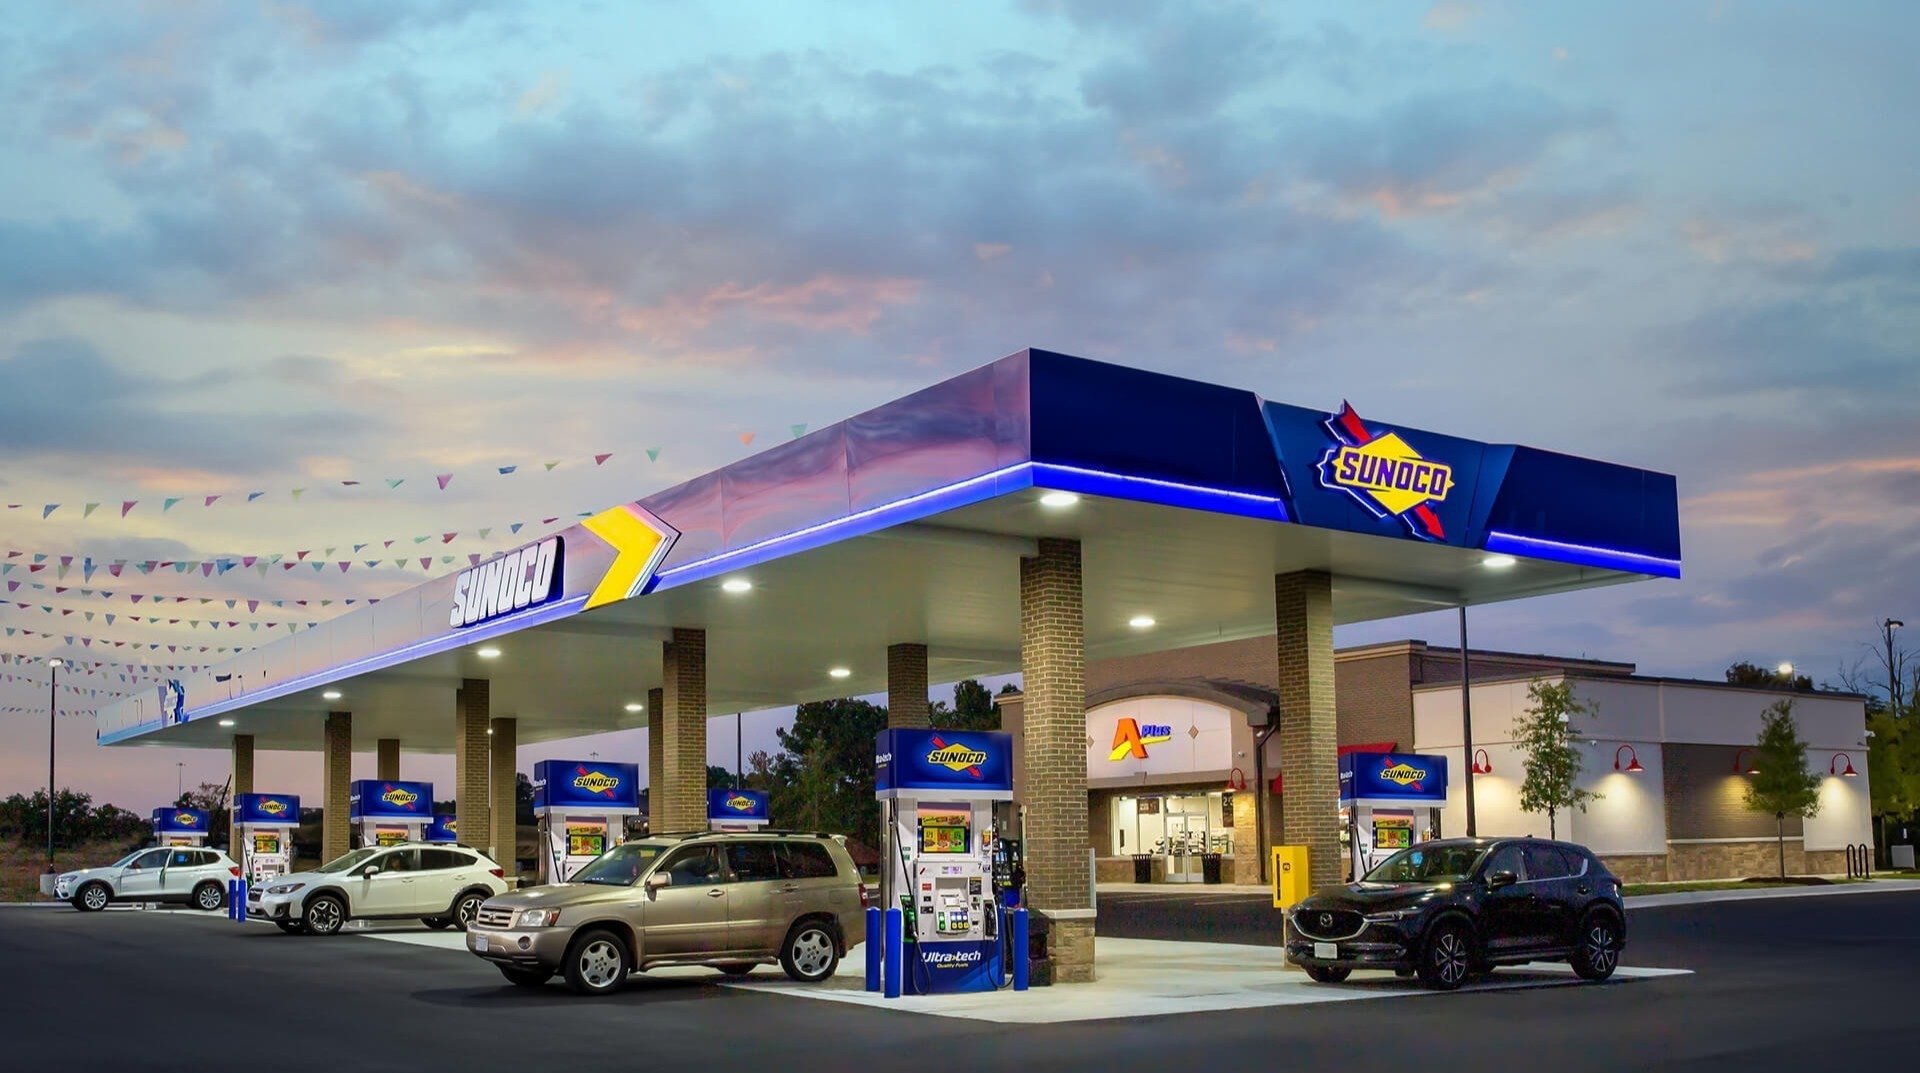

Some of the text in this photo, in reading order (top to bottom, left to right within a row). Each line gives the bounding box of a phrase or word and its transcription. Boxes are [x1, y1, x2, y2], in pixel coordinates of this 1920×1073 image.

[1339, 451, 1448, 496] SUNOCO
[449, 537, 558, 628] SUNOCO
[930, 751, 985, 764] SUNOCO
[1382, 769, 1425, 780] SUNOCO
[575, 777, 618, 788] SUNOCO
[383, 793, 417, 802] SUNOCO
